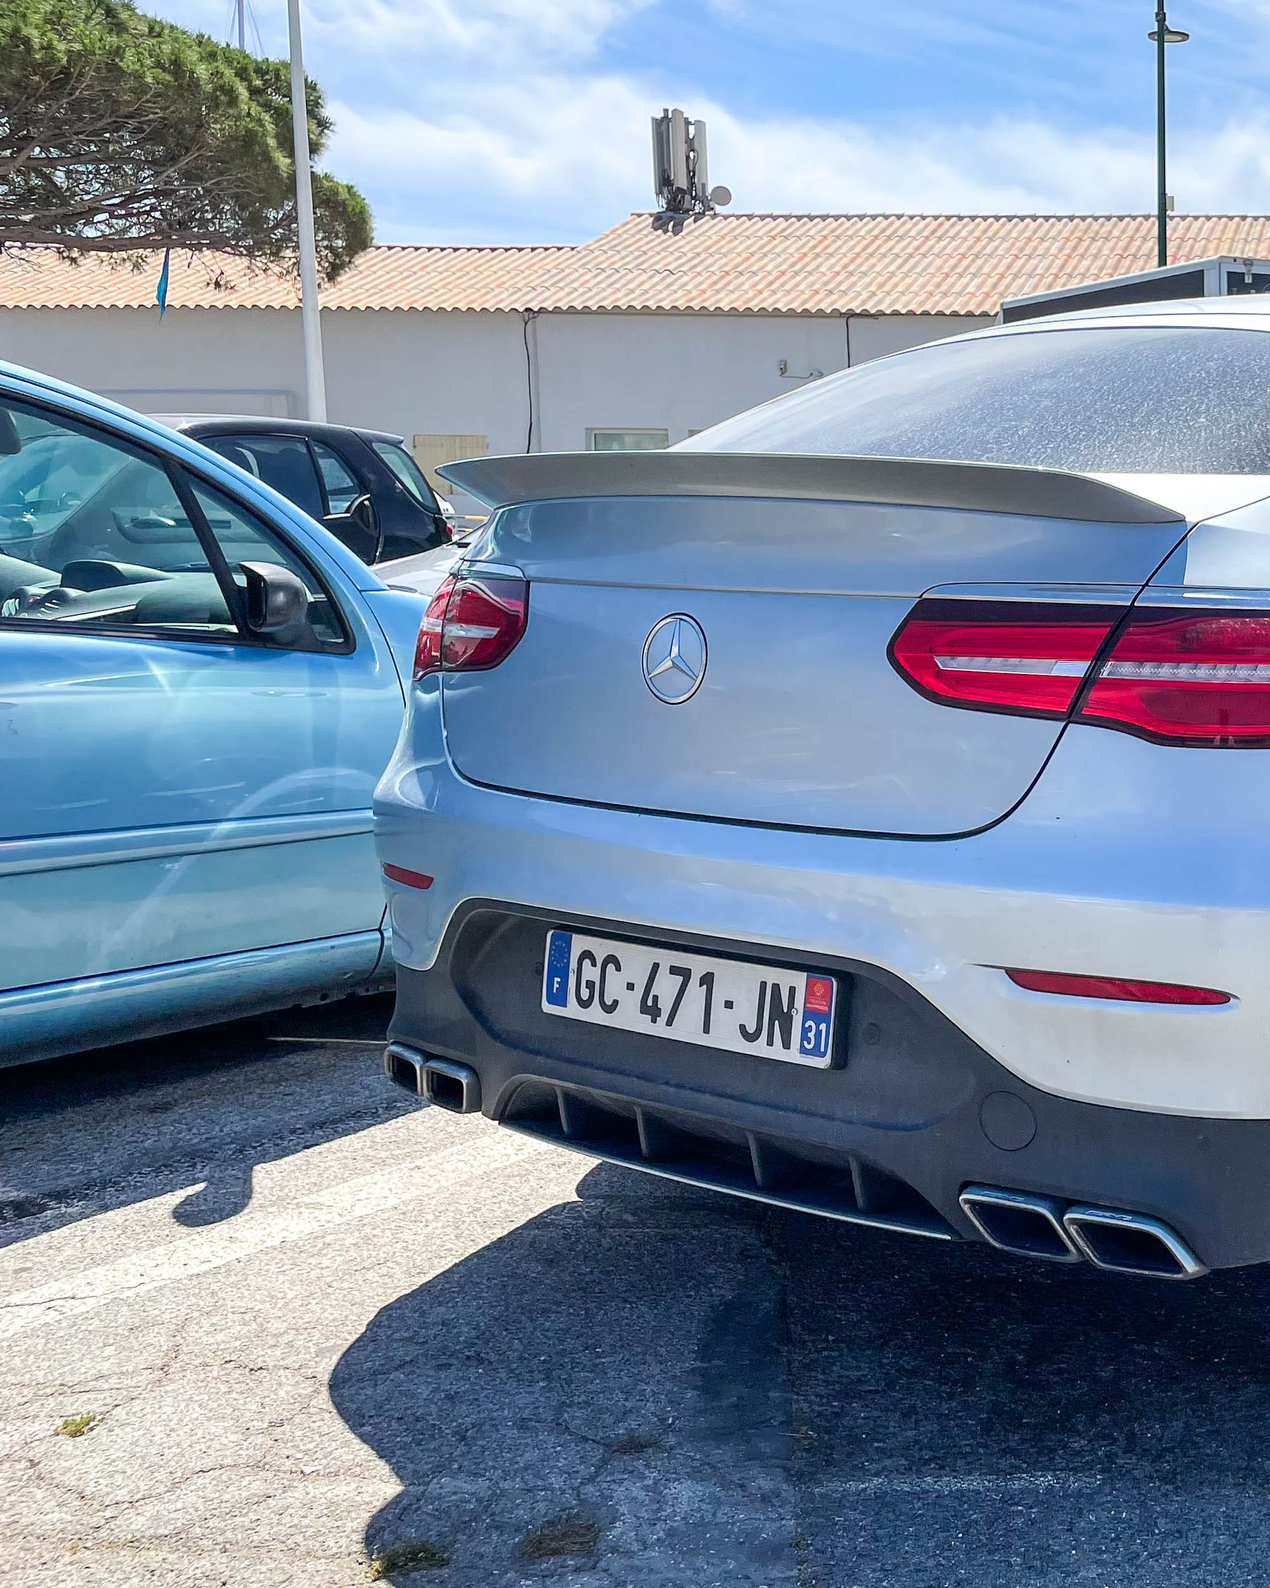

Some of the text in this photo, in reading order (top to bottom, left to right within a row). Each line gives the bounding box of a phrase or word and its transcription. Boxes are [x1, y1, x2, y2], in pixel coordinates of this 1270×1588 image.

[553, 977, 561, 994] F
[574, 949, 796, 1050] GC-471-JN
[803, 1020, 827, 1052] 31
